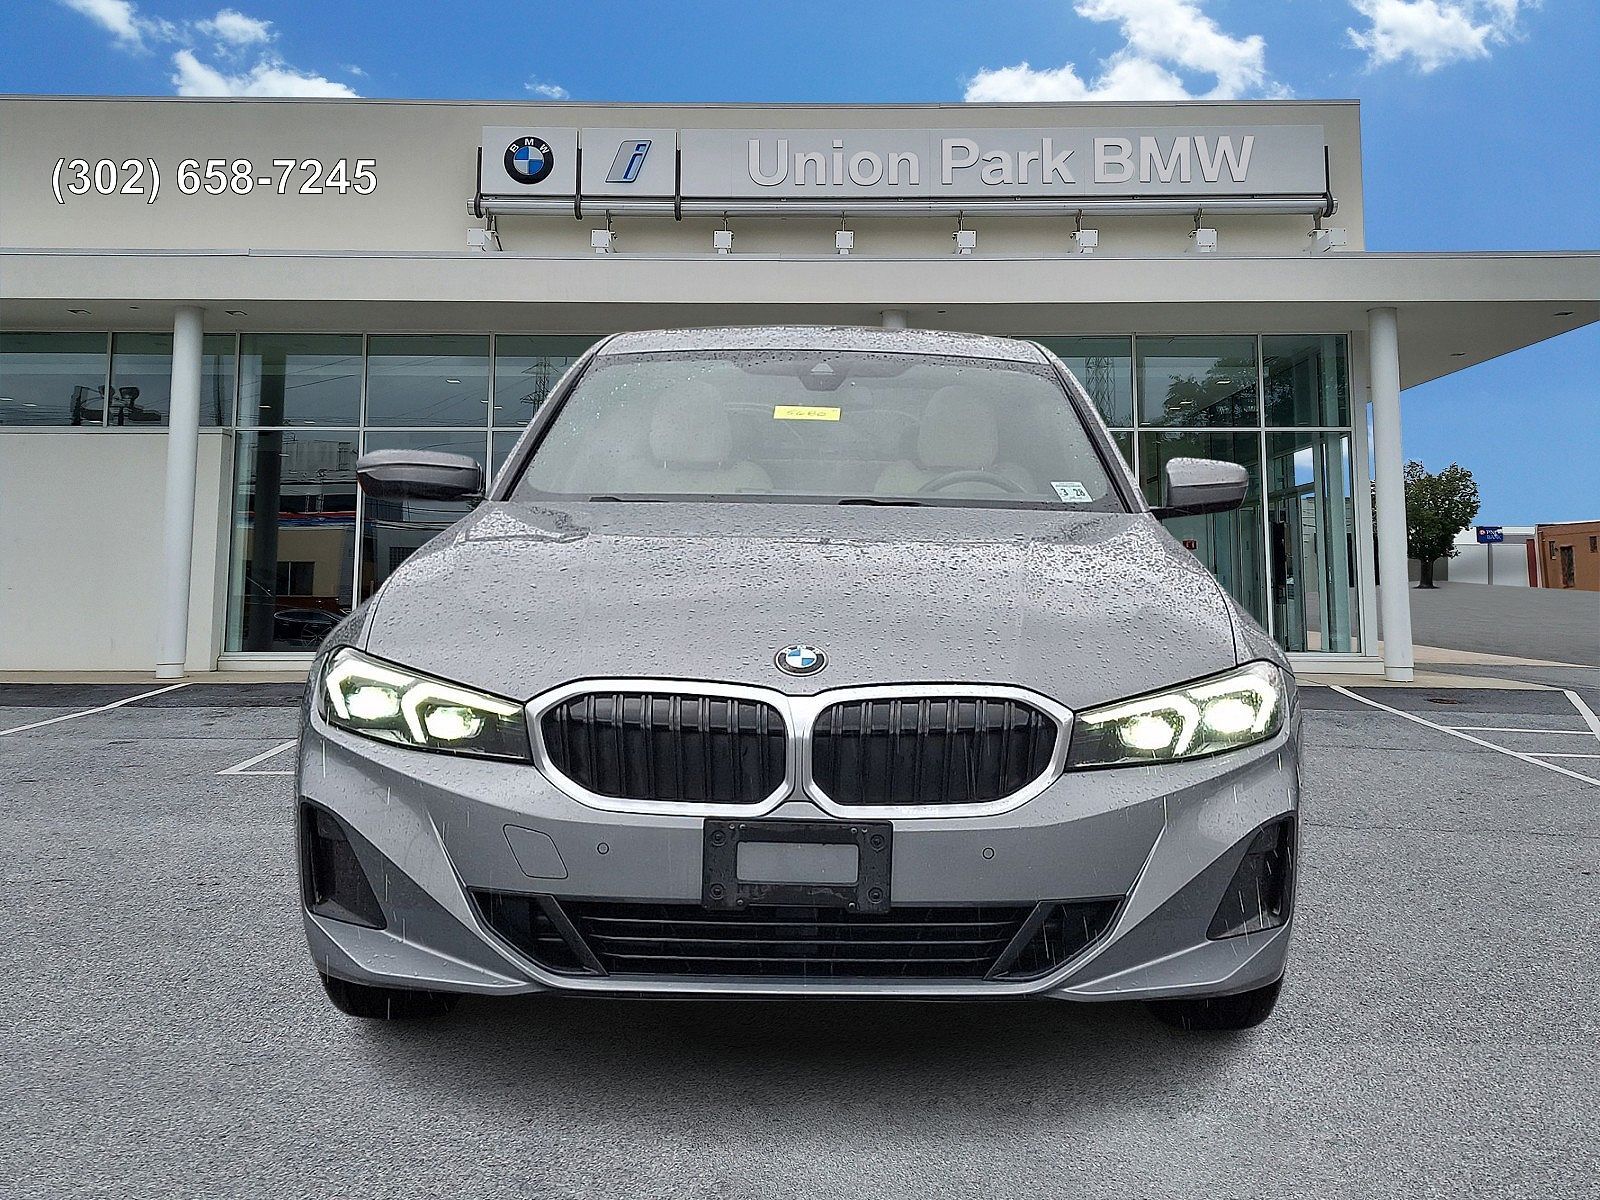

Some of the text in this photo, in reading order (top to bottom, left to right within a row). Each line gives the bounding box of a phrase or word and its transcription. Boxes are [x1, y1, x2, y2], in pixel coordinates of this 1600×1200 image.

[509, 138, 550, 154] BMW
[746, 135, 1255, 187] Union Park BMW
